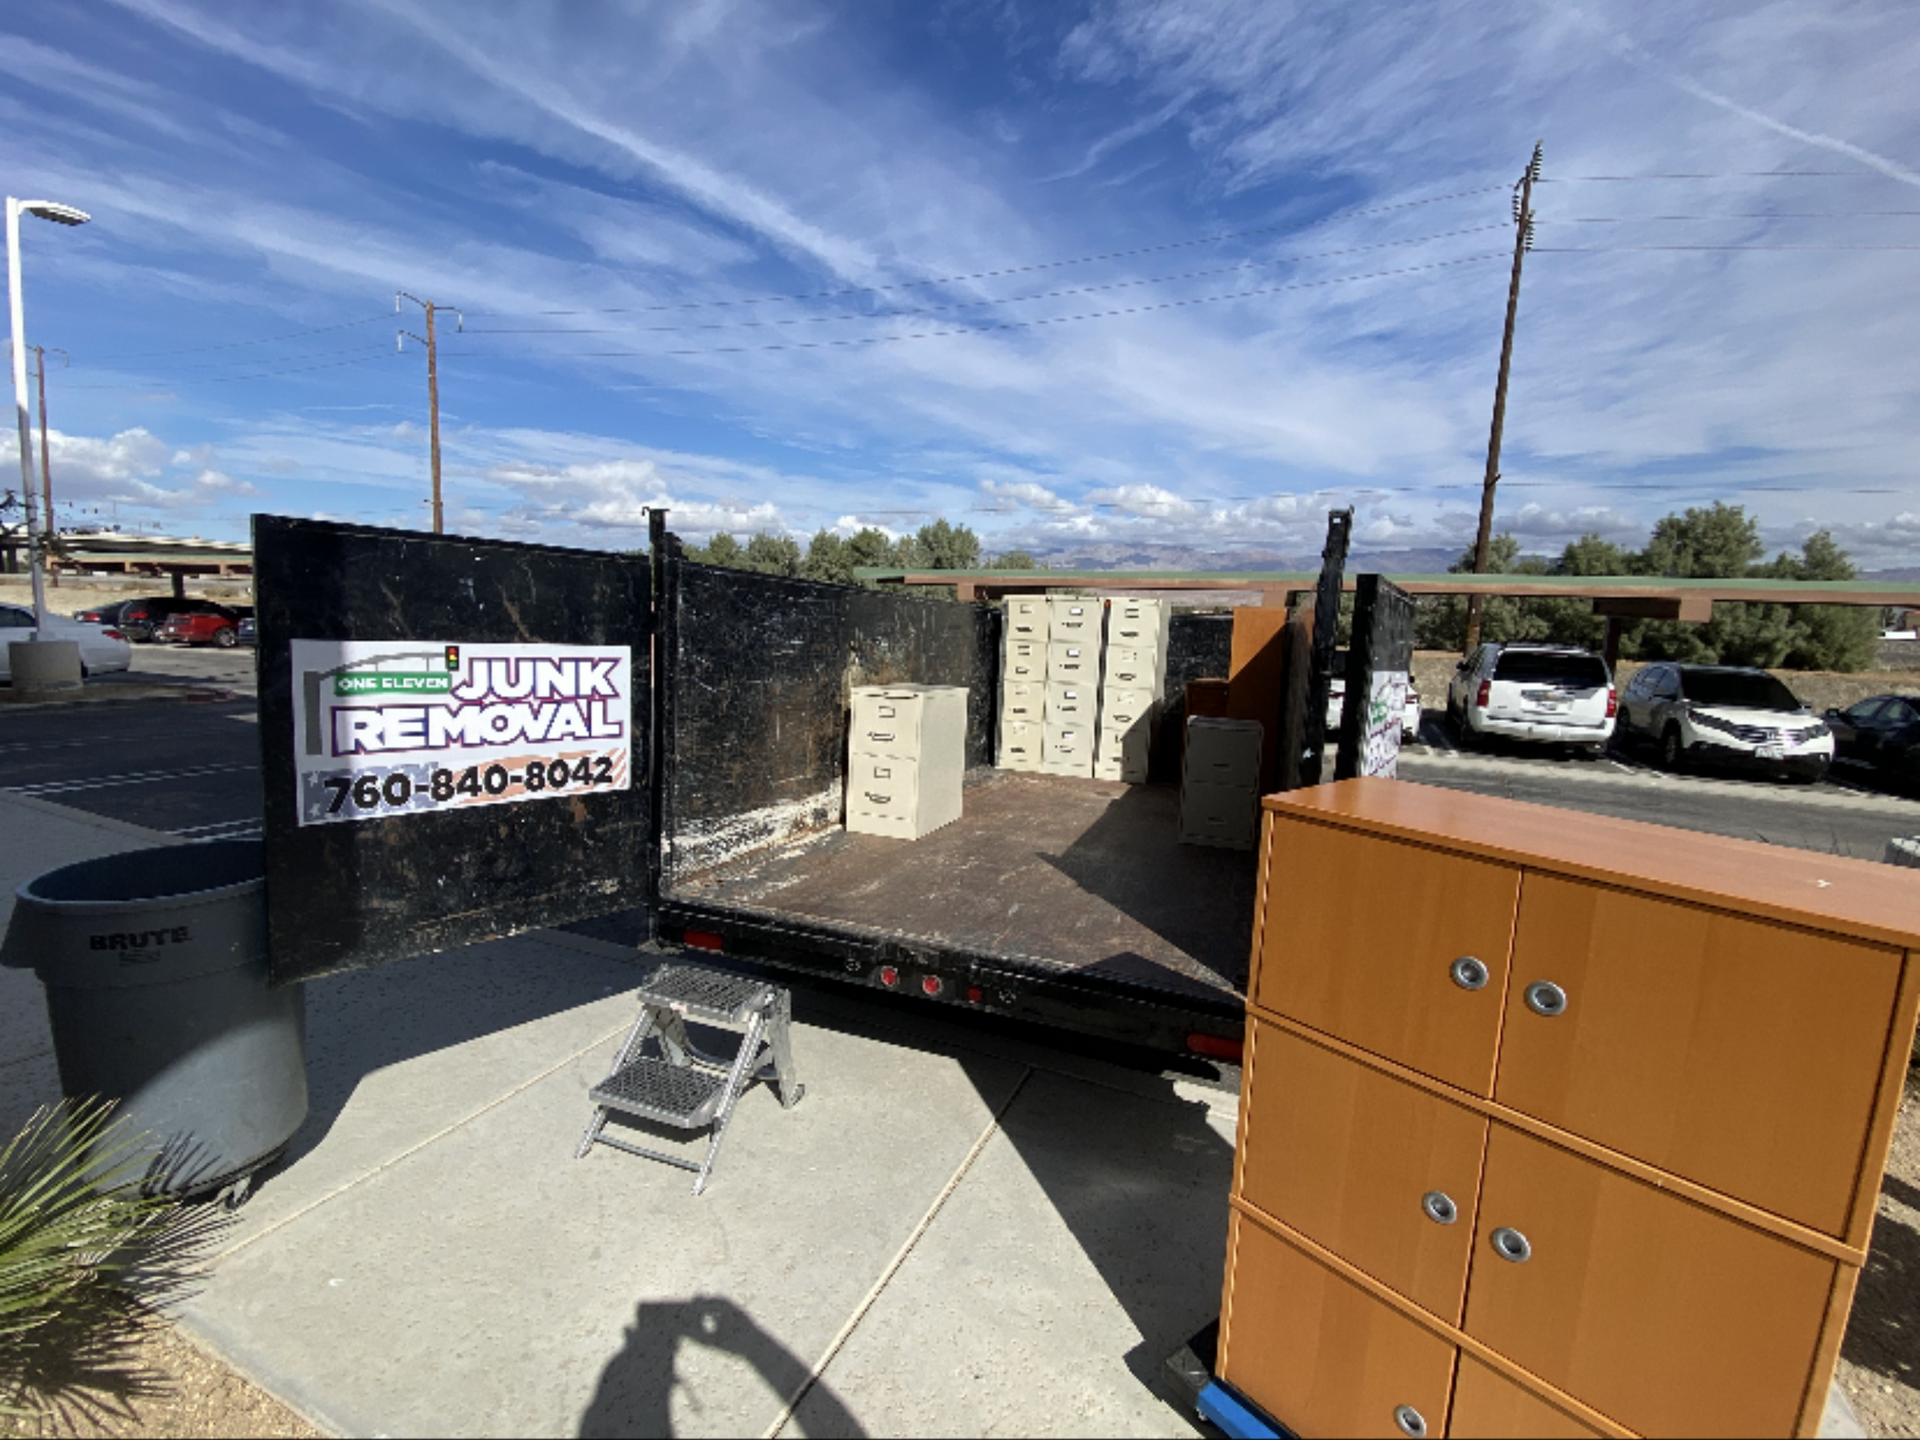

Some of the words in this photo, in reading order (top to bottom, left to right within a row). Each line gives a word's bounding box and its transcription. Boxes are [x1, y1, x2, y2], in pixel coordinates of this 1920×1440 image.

[338, 677, 377, 690] ONE
[381, 677, 449, 688] ELEVEN
[450, 656, 622, 702] JUNK
[330, 699, 624, 757] REMOVAL
[323, 756, 614, 815] 760-840-8042
[88, 926, 192, 951] BRUTE
